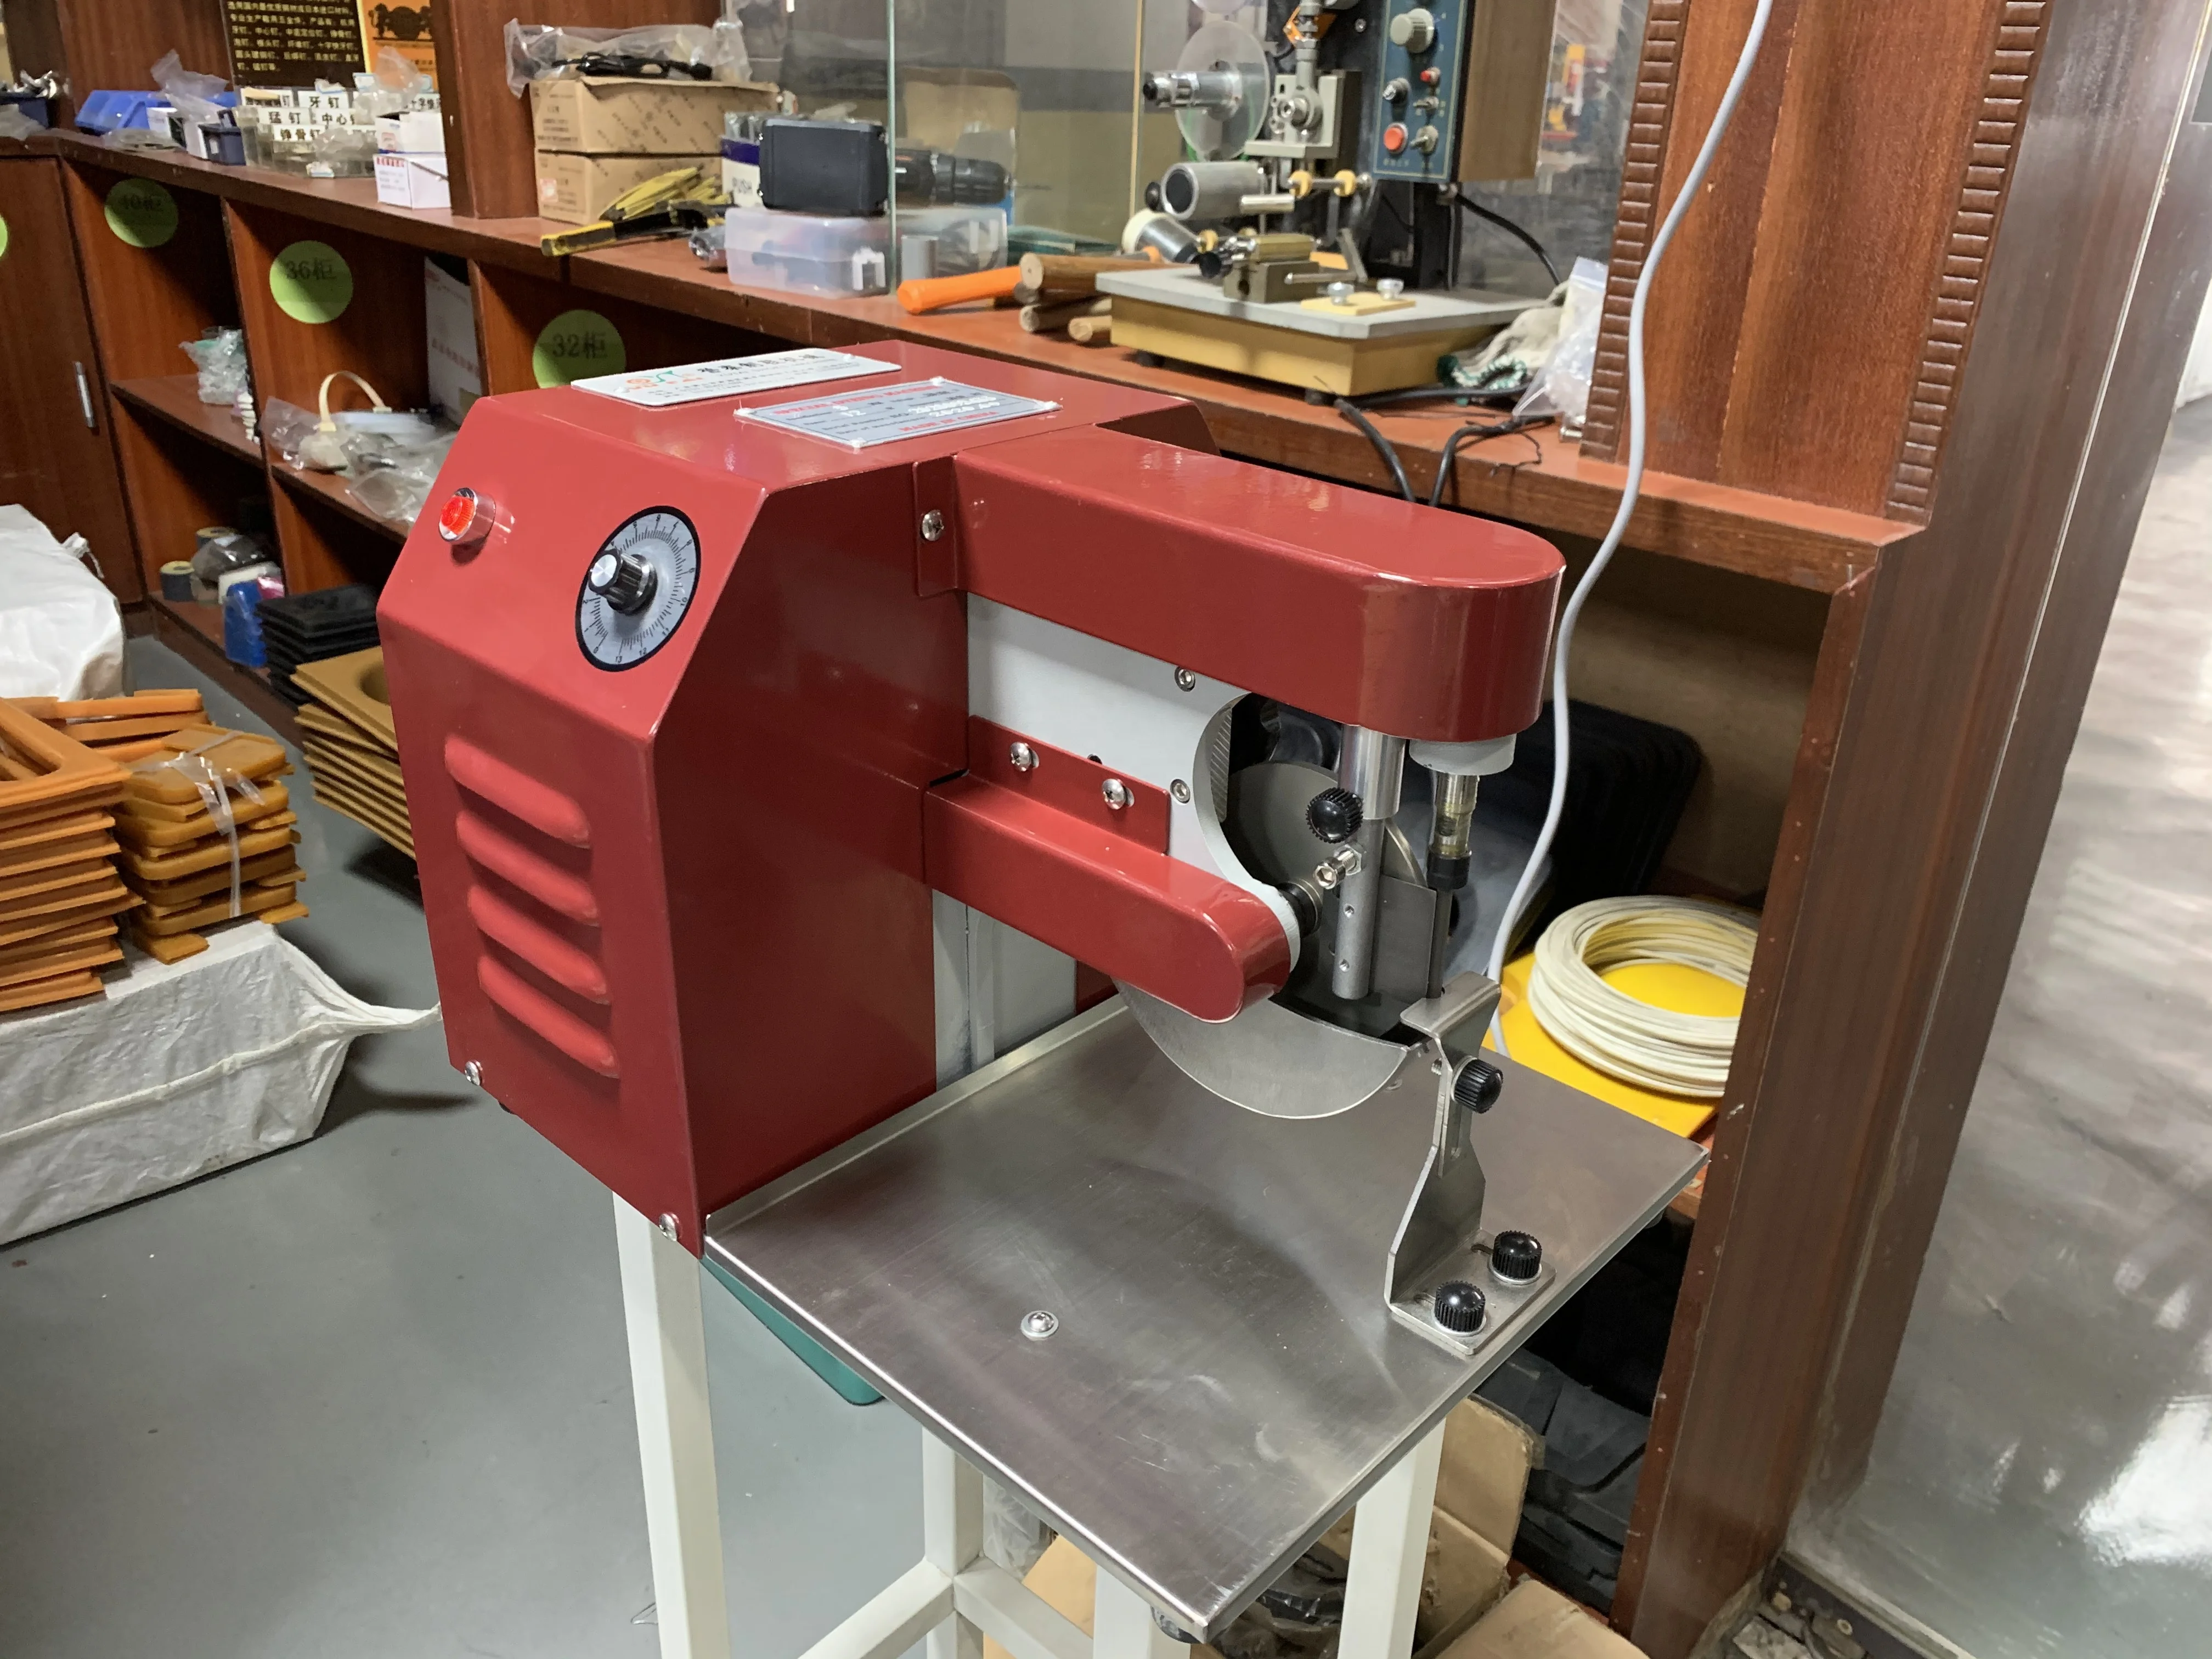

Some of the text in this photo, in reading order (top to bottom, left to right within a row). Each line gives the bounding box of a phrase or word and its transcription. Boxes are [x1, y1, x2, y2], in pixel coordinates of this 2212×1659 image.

[286, 257, 337, 280] 36柜
[552, 331, 608, 358] 32柜
[639, 647, 648, 656] 12
